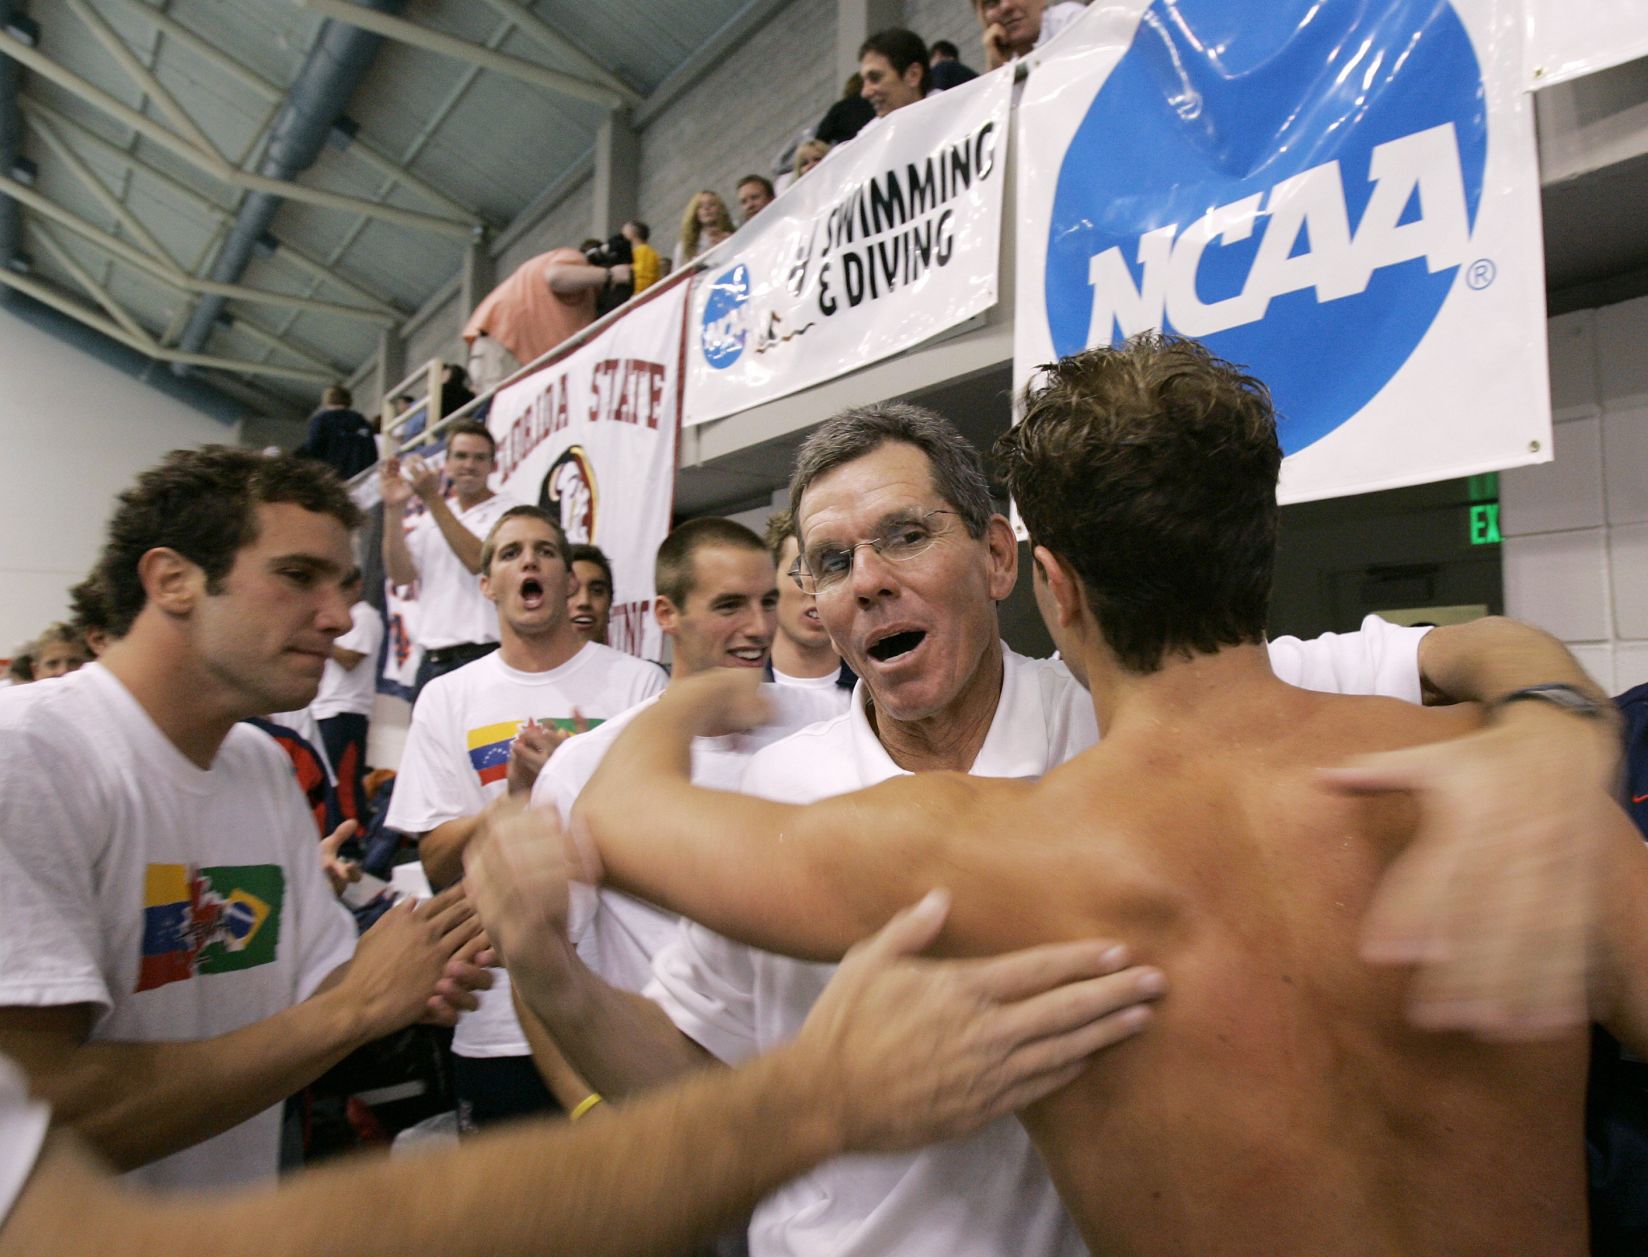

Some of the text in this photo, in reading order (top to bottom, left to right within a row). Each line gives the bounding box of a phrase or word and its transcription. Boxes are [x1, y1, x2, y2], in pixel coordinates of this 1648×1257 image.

[822, 121, 995, 257] SWIMMING
[1086, 121, 1472, 350] NCAA
[843, 208, 954, 308] DIVING
[588, 357, 666, 431] STATE
